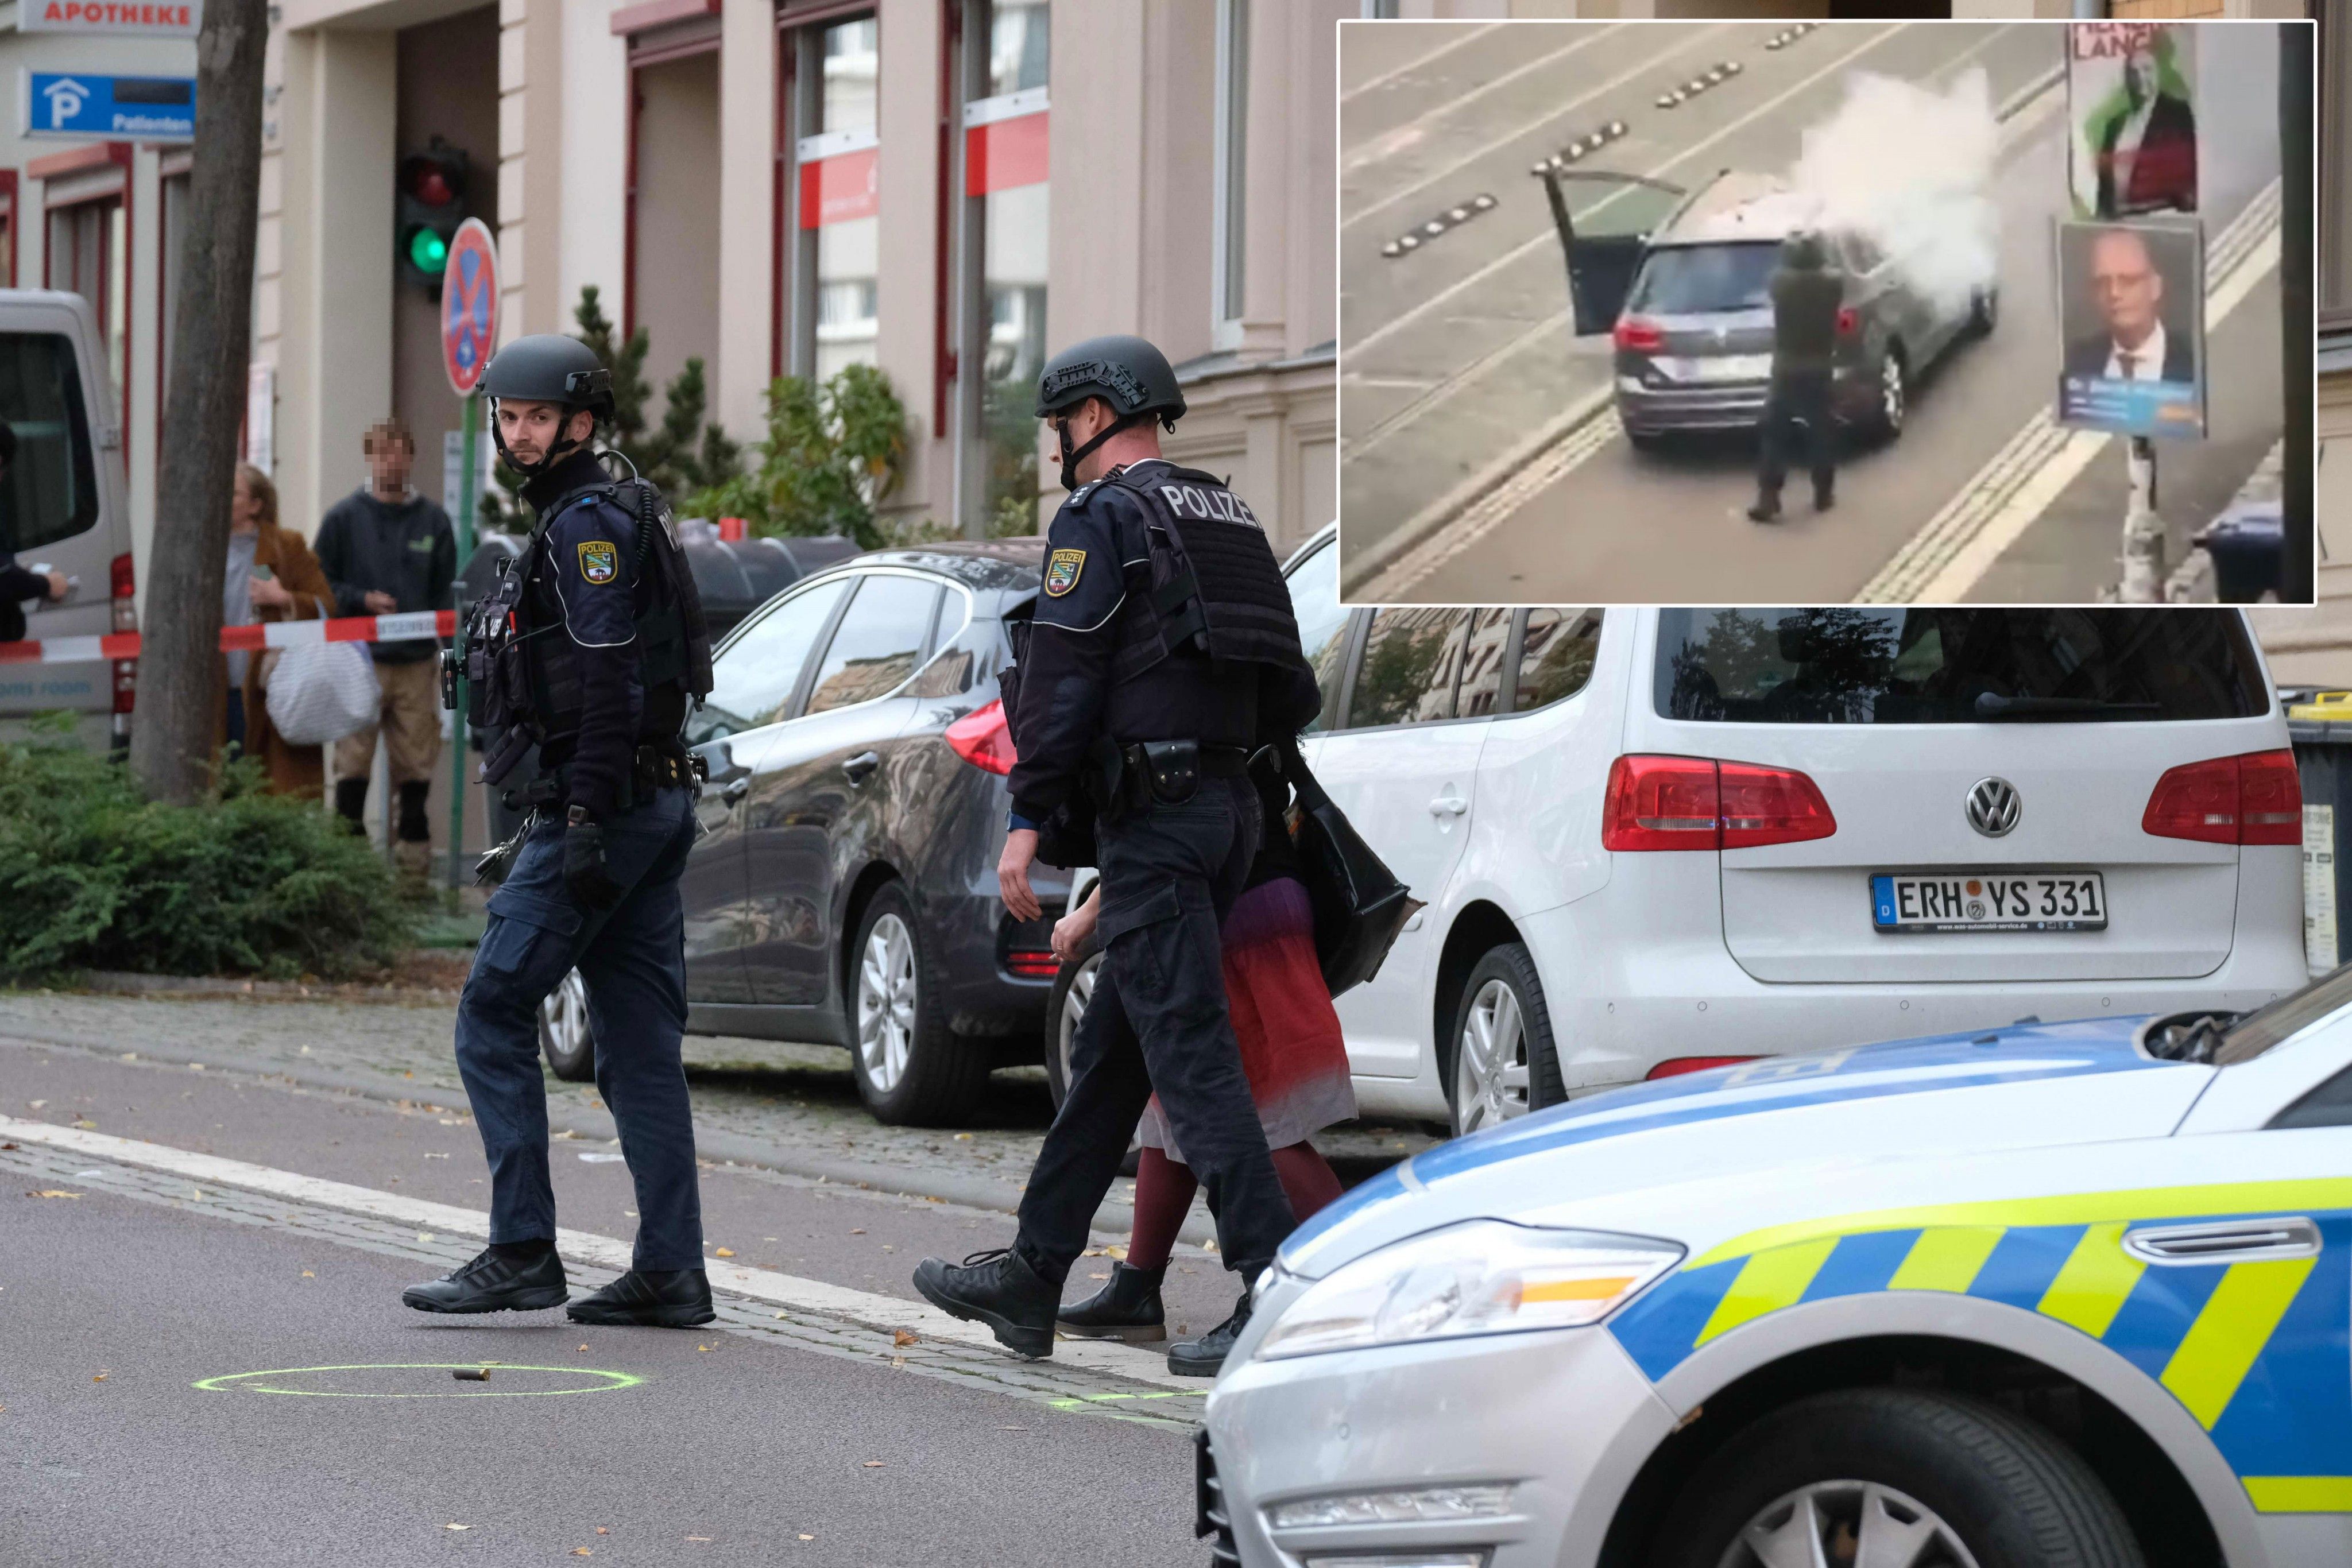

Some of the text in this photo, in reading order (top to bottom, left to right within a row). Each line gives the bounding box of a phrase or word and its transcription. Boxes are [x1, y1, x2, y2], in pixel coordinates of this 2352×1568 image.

[44, 2, 190, 26] APOTHEKE
[113, 114, 192, 132] Patienten
[581, 544, 613, 555] POLIZEI
[1054, 552, 1082, 563] POLIZEI
[1898, 880, 2100, 919] ERH YS 331
[1882, 905, 1890, 917] D
[1937, 923, 2028, 931] www.was-automobil-service.de
